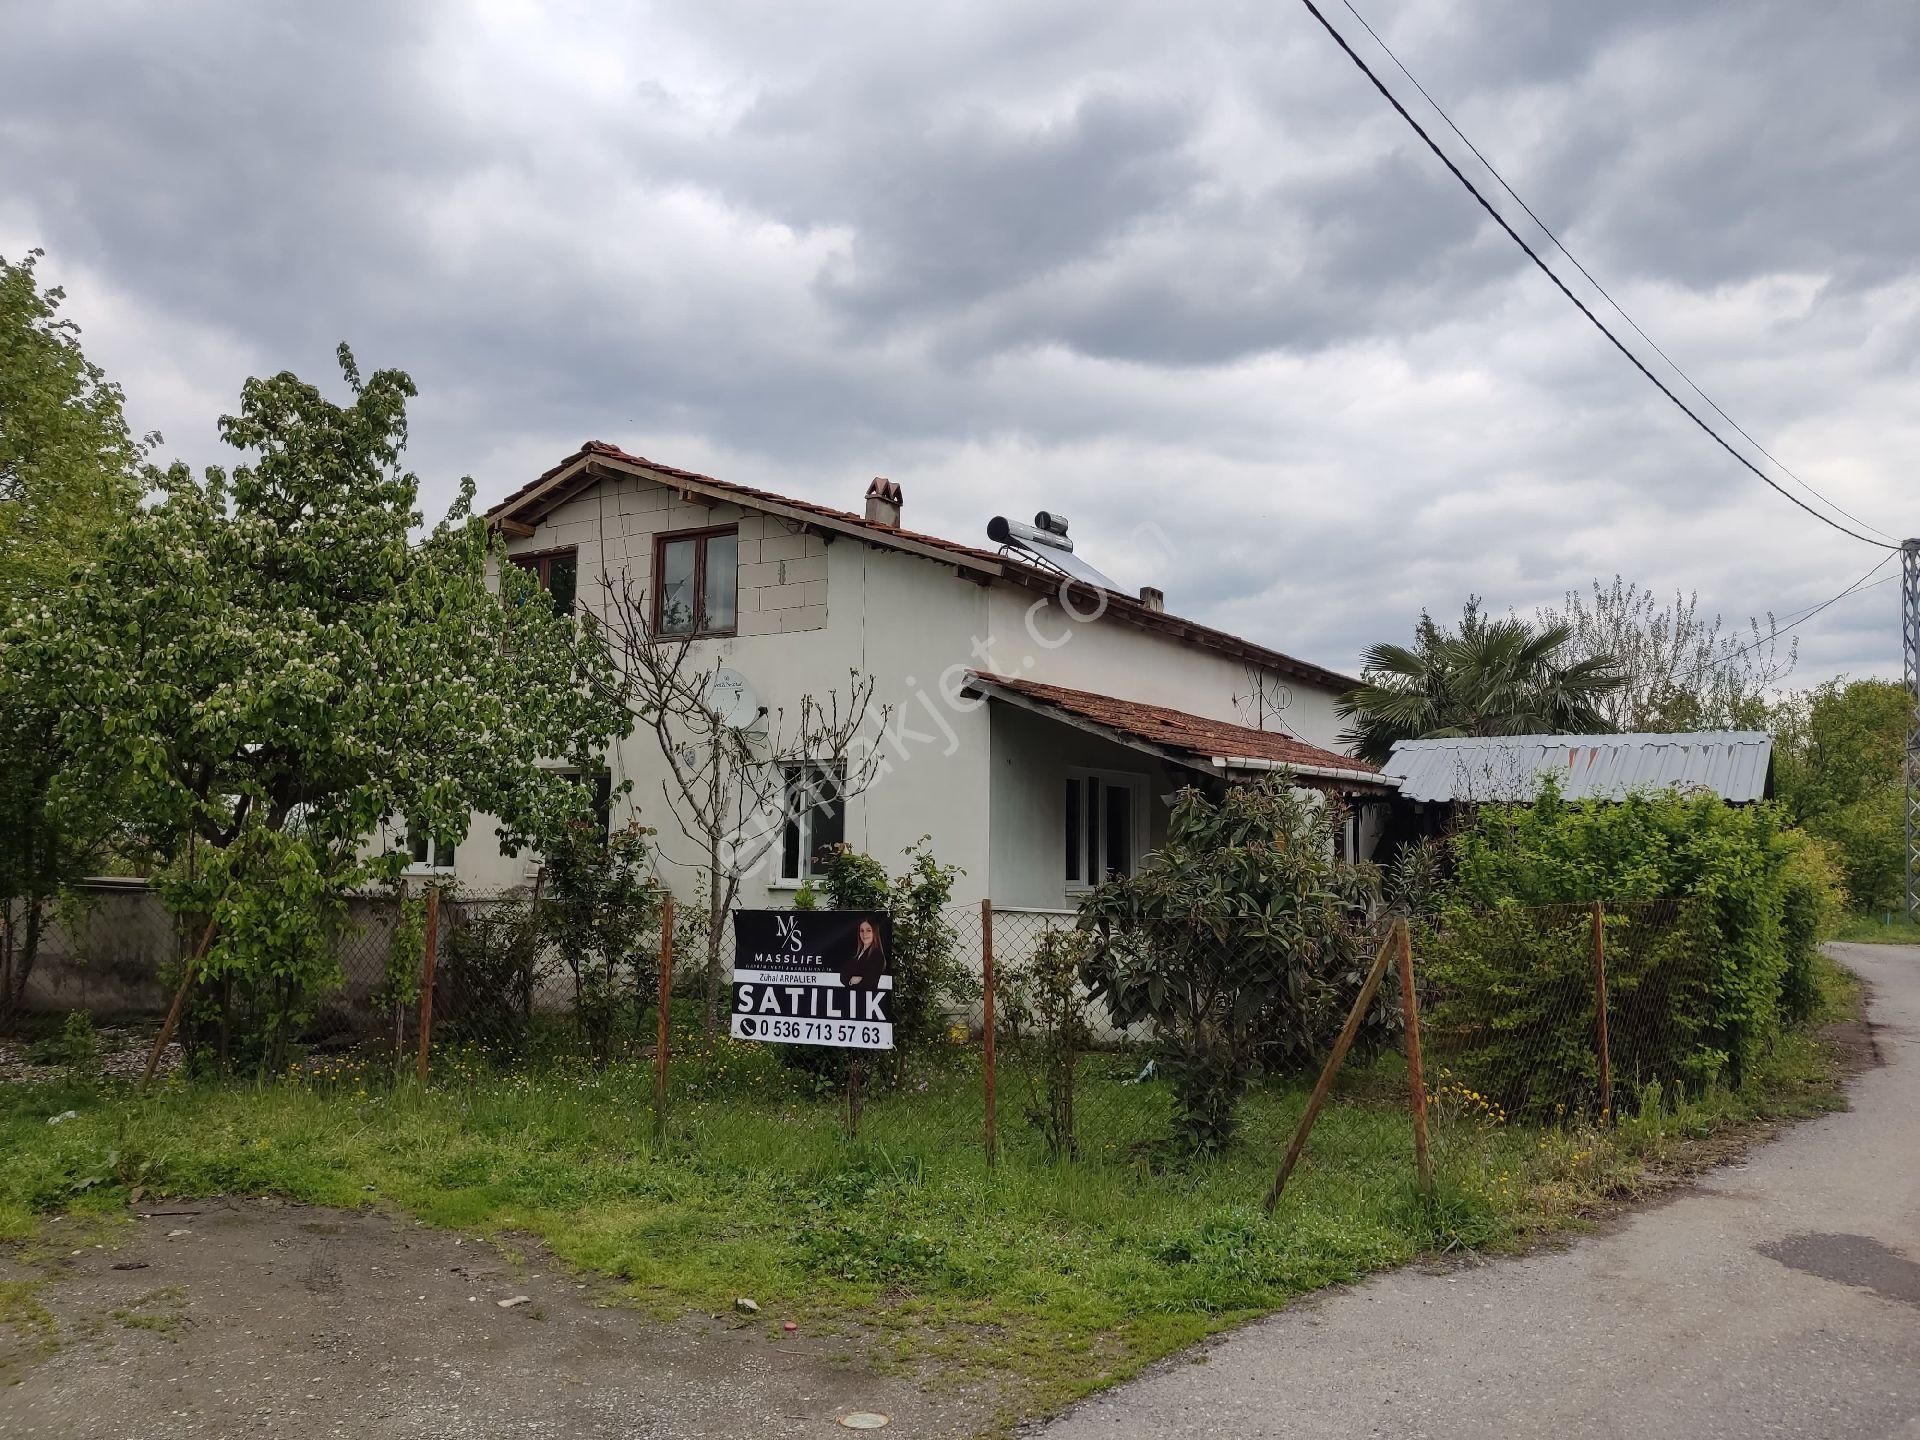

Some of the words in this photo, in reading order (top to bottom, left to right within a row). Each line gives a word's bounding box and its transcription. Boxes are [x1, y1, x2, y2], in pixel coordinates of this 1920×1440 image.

[754, 953, 823, 965] MASSLIFE
[738, 985, 887, 1021] SATILIK
[760, 1020, 769, 1036] 0
[773, 1021, 800, 1038] 536
[805, 1023, 832, 1041] 713
[838, 1026, 856, 1042] 57
[861, 1027, 880, 1044] 63
